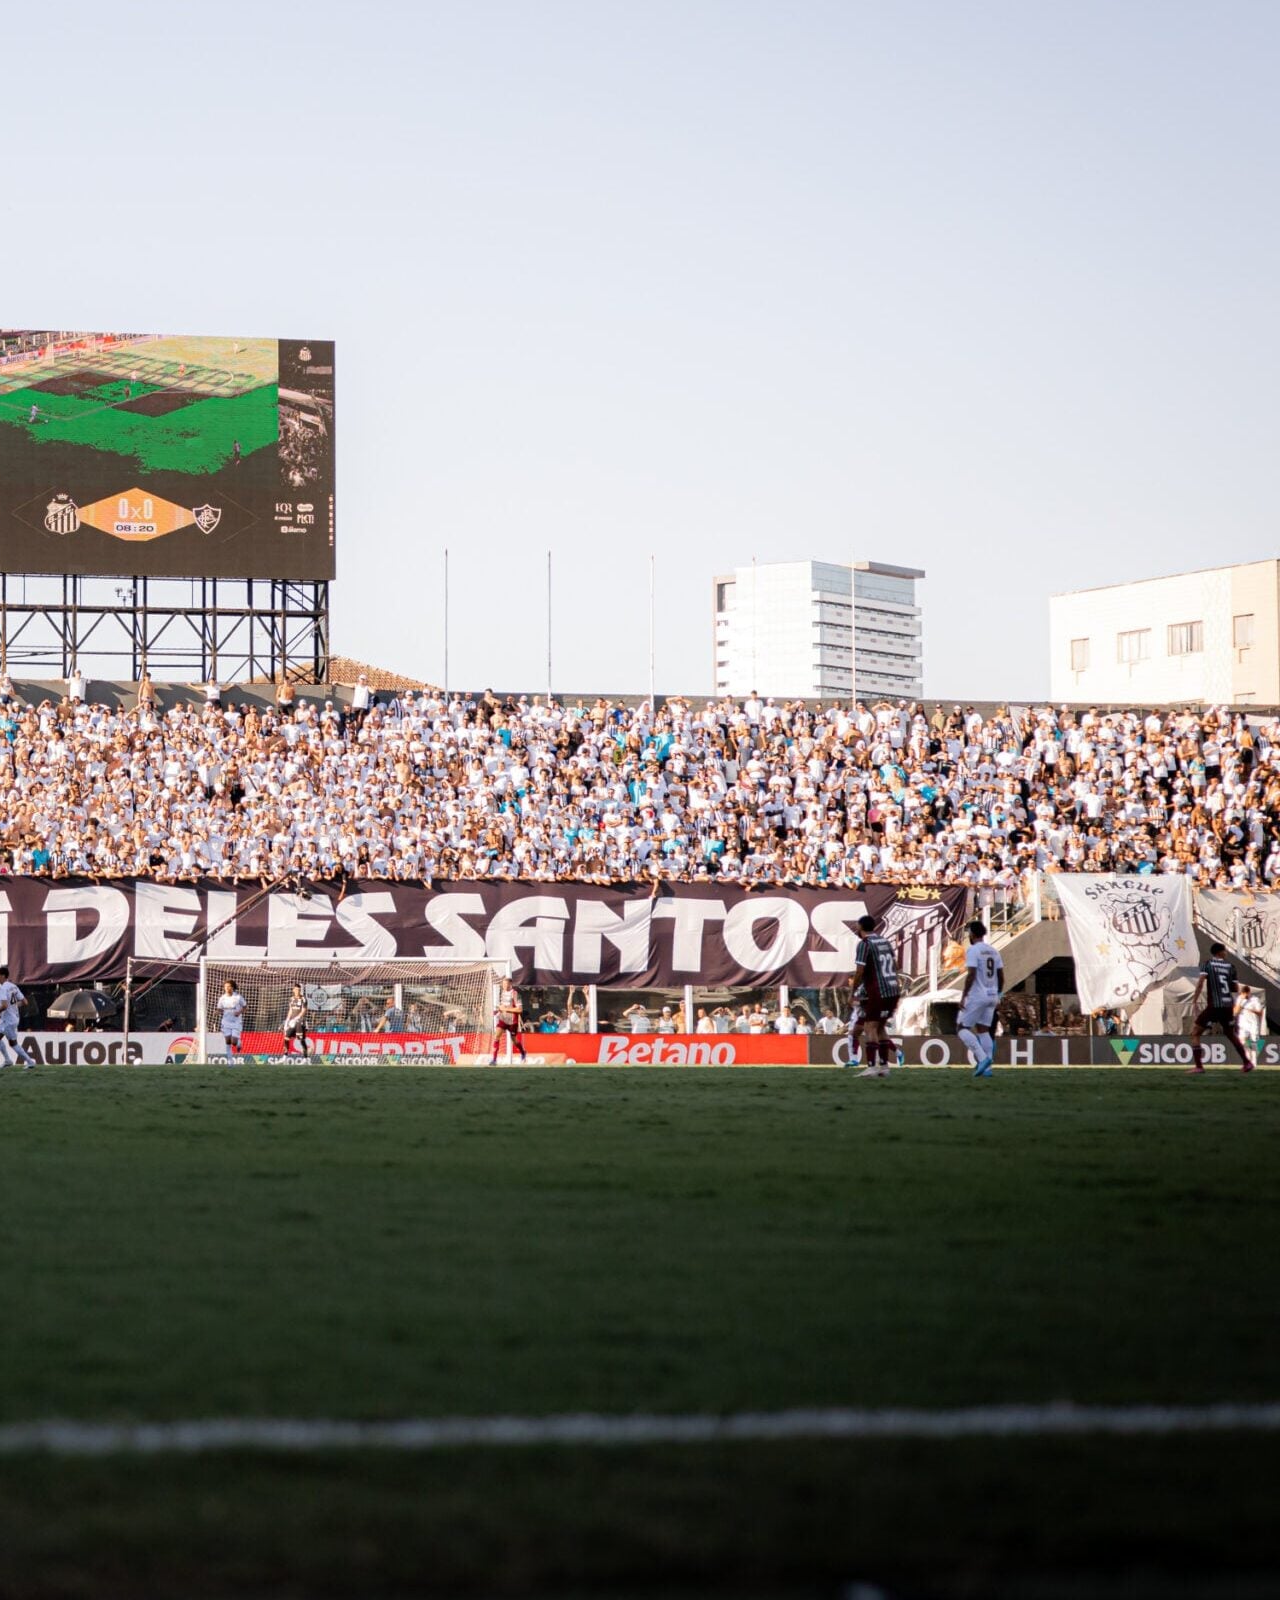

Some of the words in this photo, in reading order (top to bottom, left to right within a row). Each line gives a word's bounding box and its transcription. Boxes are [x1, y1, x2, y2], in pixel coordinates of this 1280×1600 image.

[118, 498, 129, 519] 0
[144, 499, 153, 520] 0
[116, 524, 154, 532] 08:20
[42, 882, 398, 965] DELES
[423, 892, 869, 974] SANTOS
[879, 953, 897, 977] 22
[987, 957, 994, 979] 9
[1219, 975, 1230, 994] 5
[16, 1036, 143, 1065] Aurora
[207, 1056, 245, 1065] ICOB
[598, 1035, 736, 1065] Betano
[1265, 1043, 1280, 1064] S
